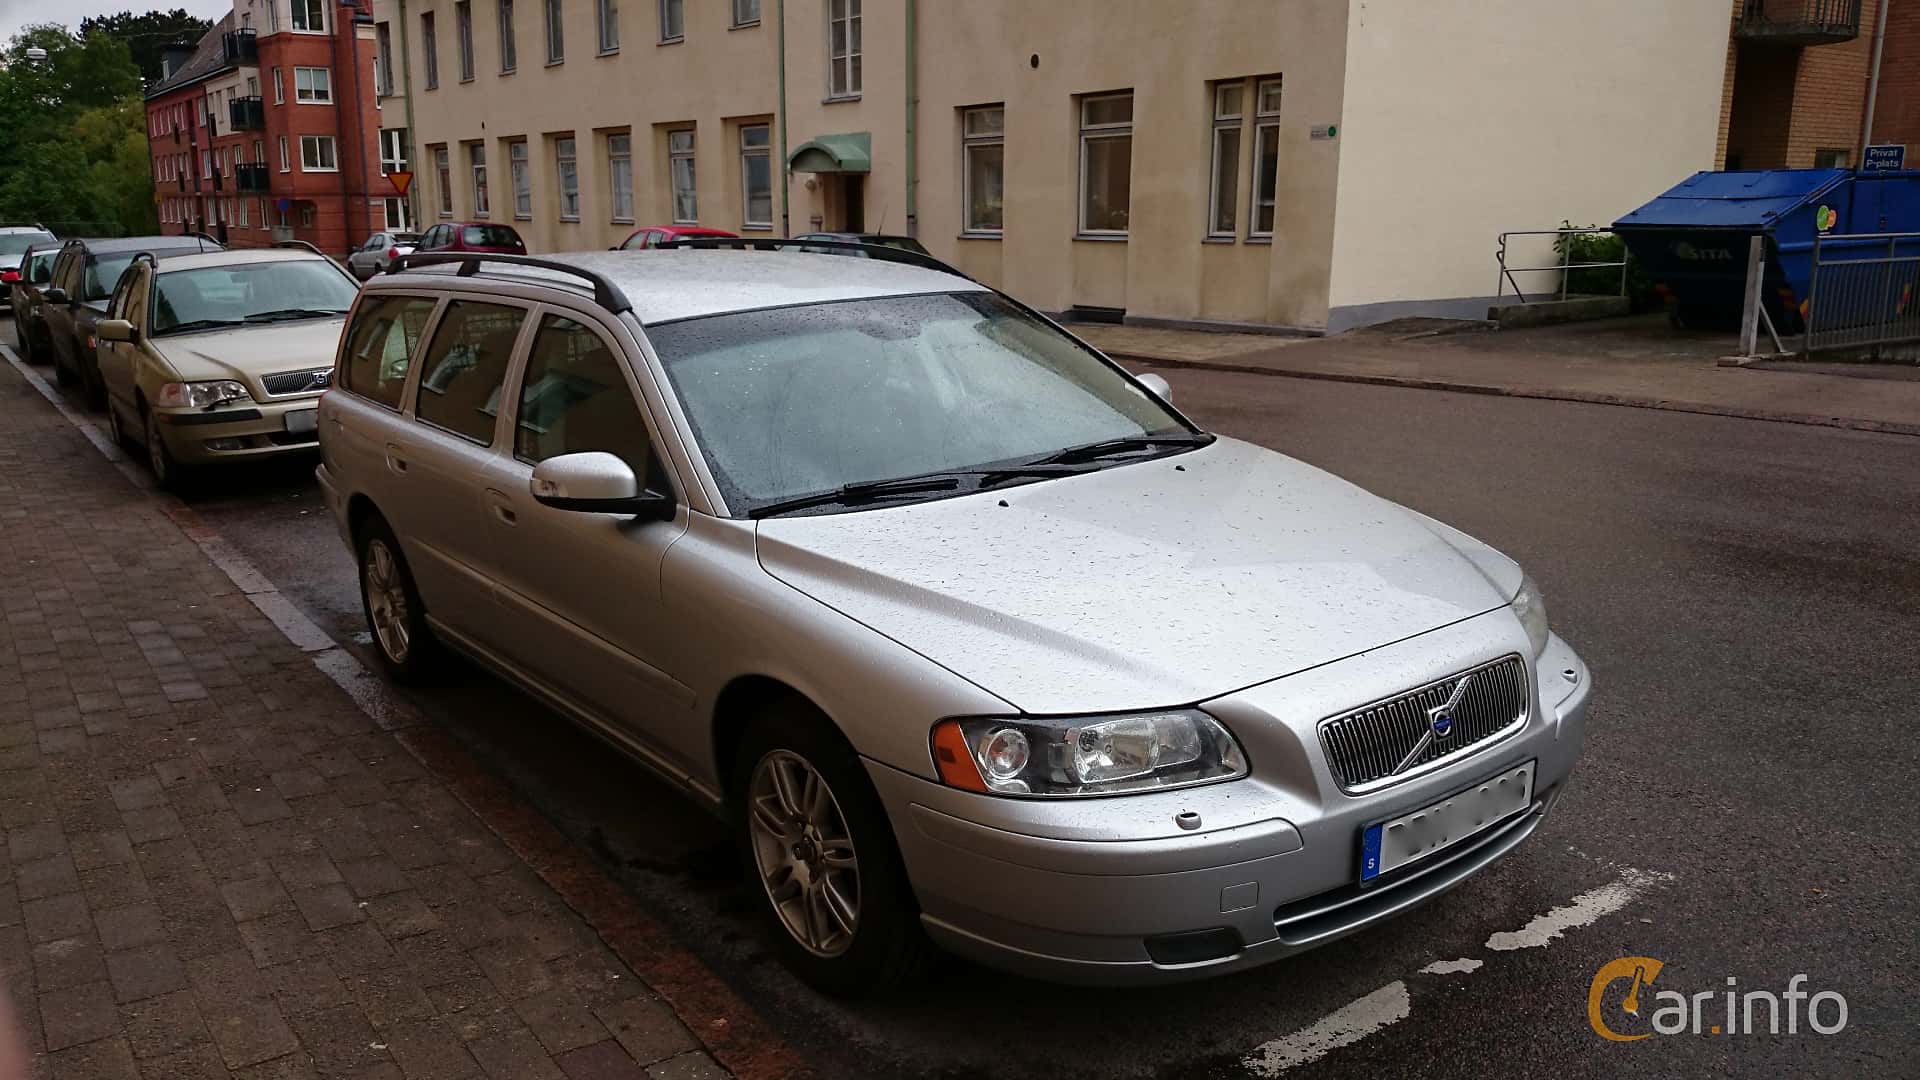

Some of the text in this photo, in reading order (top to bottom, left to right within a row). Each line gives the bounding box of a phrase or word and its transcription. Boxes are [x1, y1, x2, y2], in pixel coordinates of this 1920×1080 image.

[1870, 148, 1898, 157] Privat
[1866, 159, 1900, 169] P-plats
[1367, 857, 1375, 869] S
